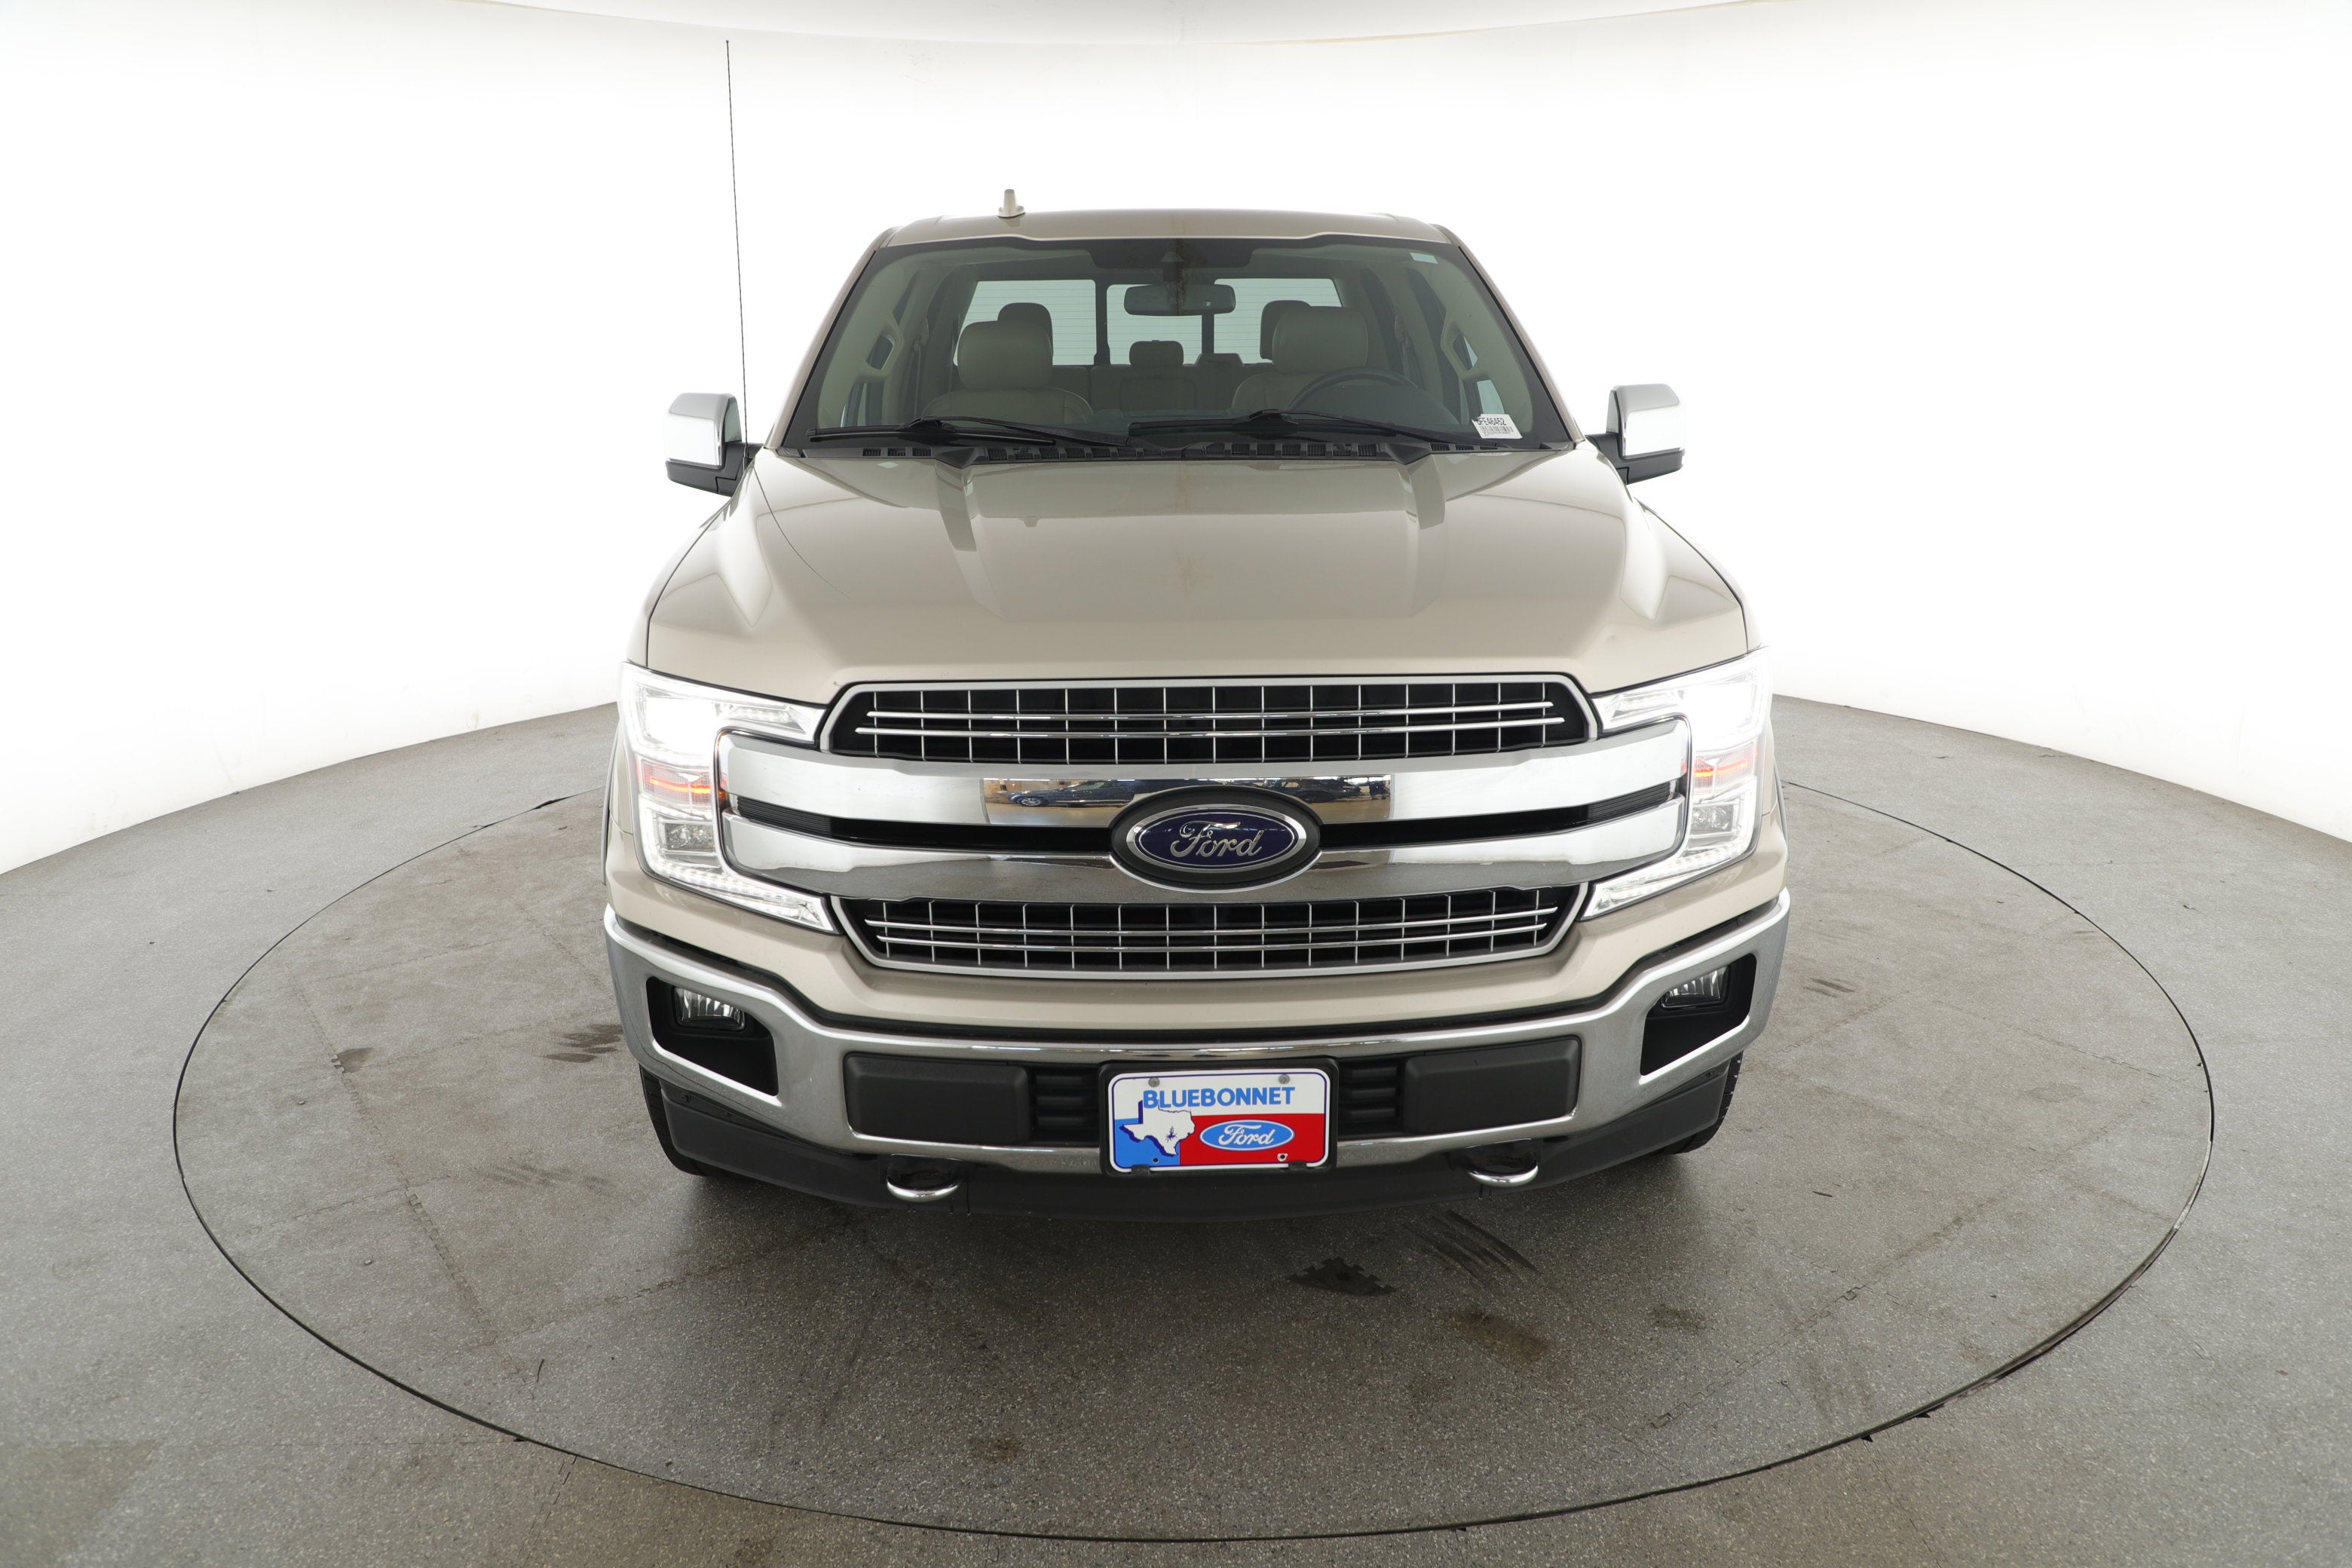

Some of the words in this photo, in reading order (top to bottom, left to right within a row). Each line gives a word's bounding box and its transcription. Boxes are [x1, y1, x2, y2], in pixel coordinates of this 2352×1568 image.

[1170, 820, 1264, 858] Ford
[1143, 1087, 1295, 1108] BLUEBONNET
[1218, 1124, 1275, 1145] Ford
